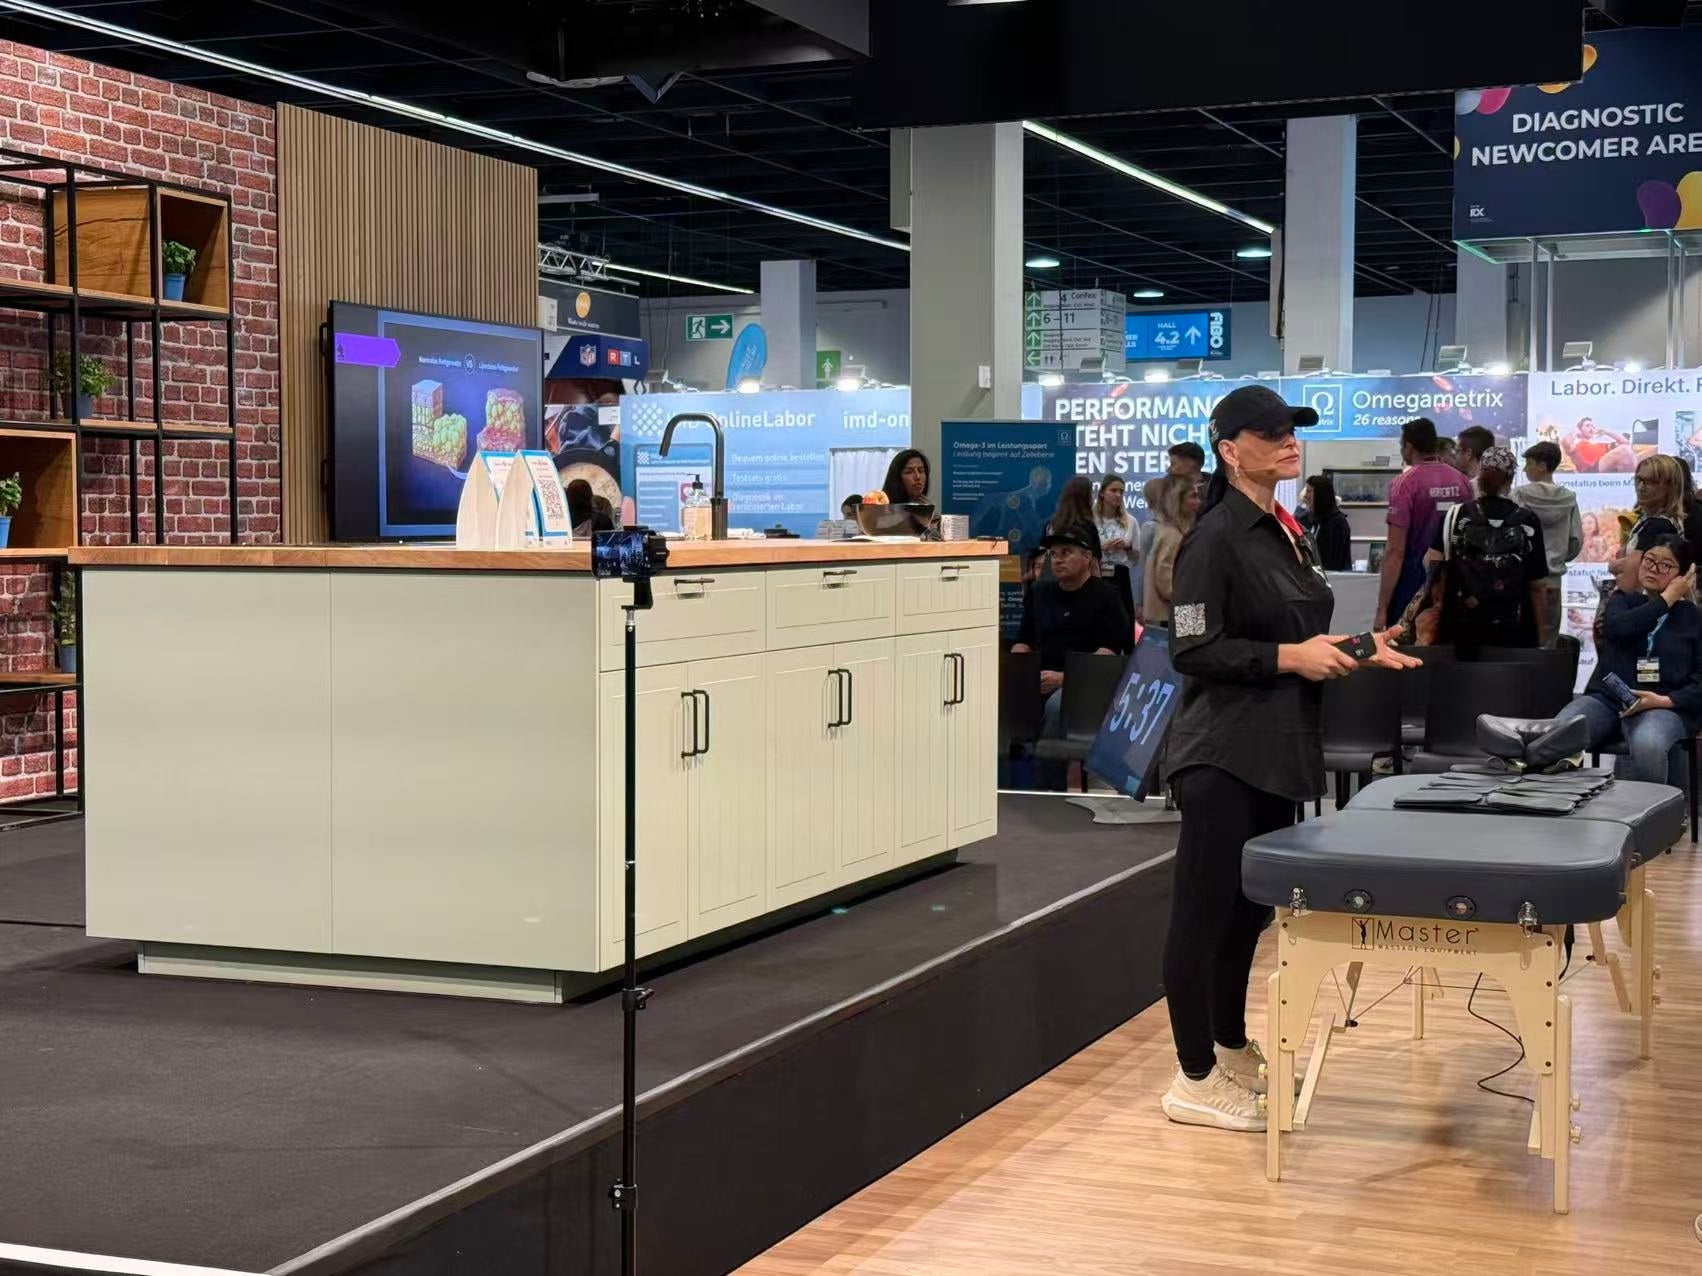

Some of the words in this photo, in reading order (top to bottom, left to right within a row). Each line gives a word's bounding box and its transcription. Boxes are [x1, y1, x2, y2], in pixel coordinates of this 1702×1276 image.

[1512, 102, 1685, 133] DIAGNOSTIC
[1471, 136, 1639, 167] NEWCOMER
[1071, 292, 1097, 300] Confex
[1043, 313, 1051, 324] 6
[1063, 312, 1074, 324] 11
[1154, 331, 1180, 344] 4.2
[1209, 312, 1224, 349] FIBO
[465, 359, 473, 369] VS
[609, 351, 640, 366] RTL
[1551, 379, 1616, 396] Labor.
[1622, 377, 1689, 394] Direkt.
[1352, 389, 1503, 412] Omegametrix
[707, 409, 816, 429] nlineLabor
[843, 410, 909, 429] imd-on
[1353, 413, 1370, 426] 26
[1141, 424, 1210, 447] NICH
[953, 441, 985, 450] Omega-3
[997, 441, 1047, 451] Leistungssport
[731, 454, 763, 464] Bequem
[765, 454, 788, 462] online
[1109, 672, 1175, 745] 5:37
[1376, 919, 1477, 945] Master
[1378, 944, 1418, 953] MASSAGE
[1424, 946, 1478, 956] EQUIPMENT
